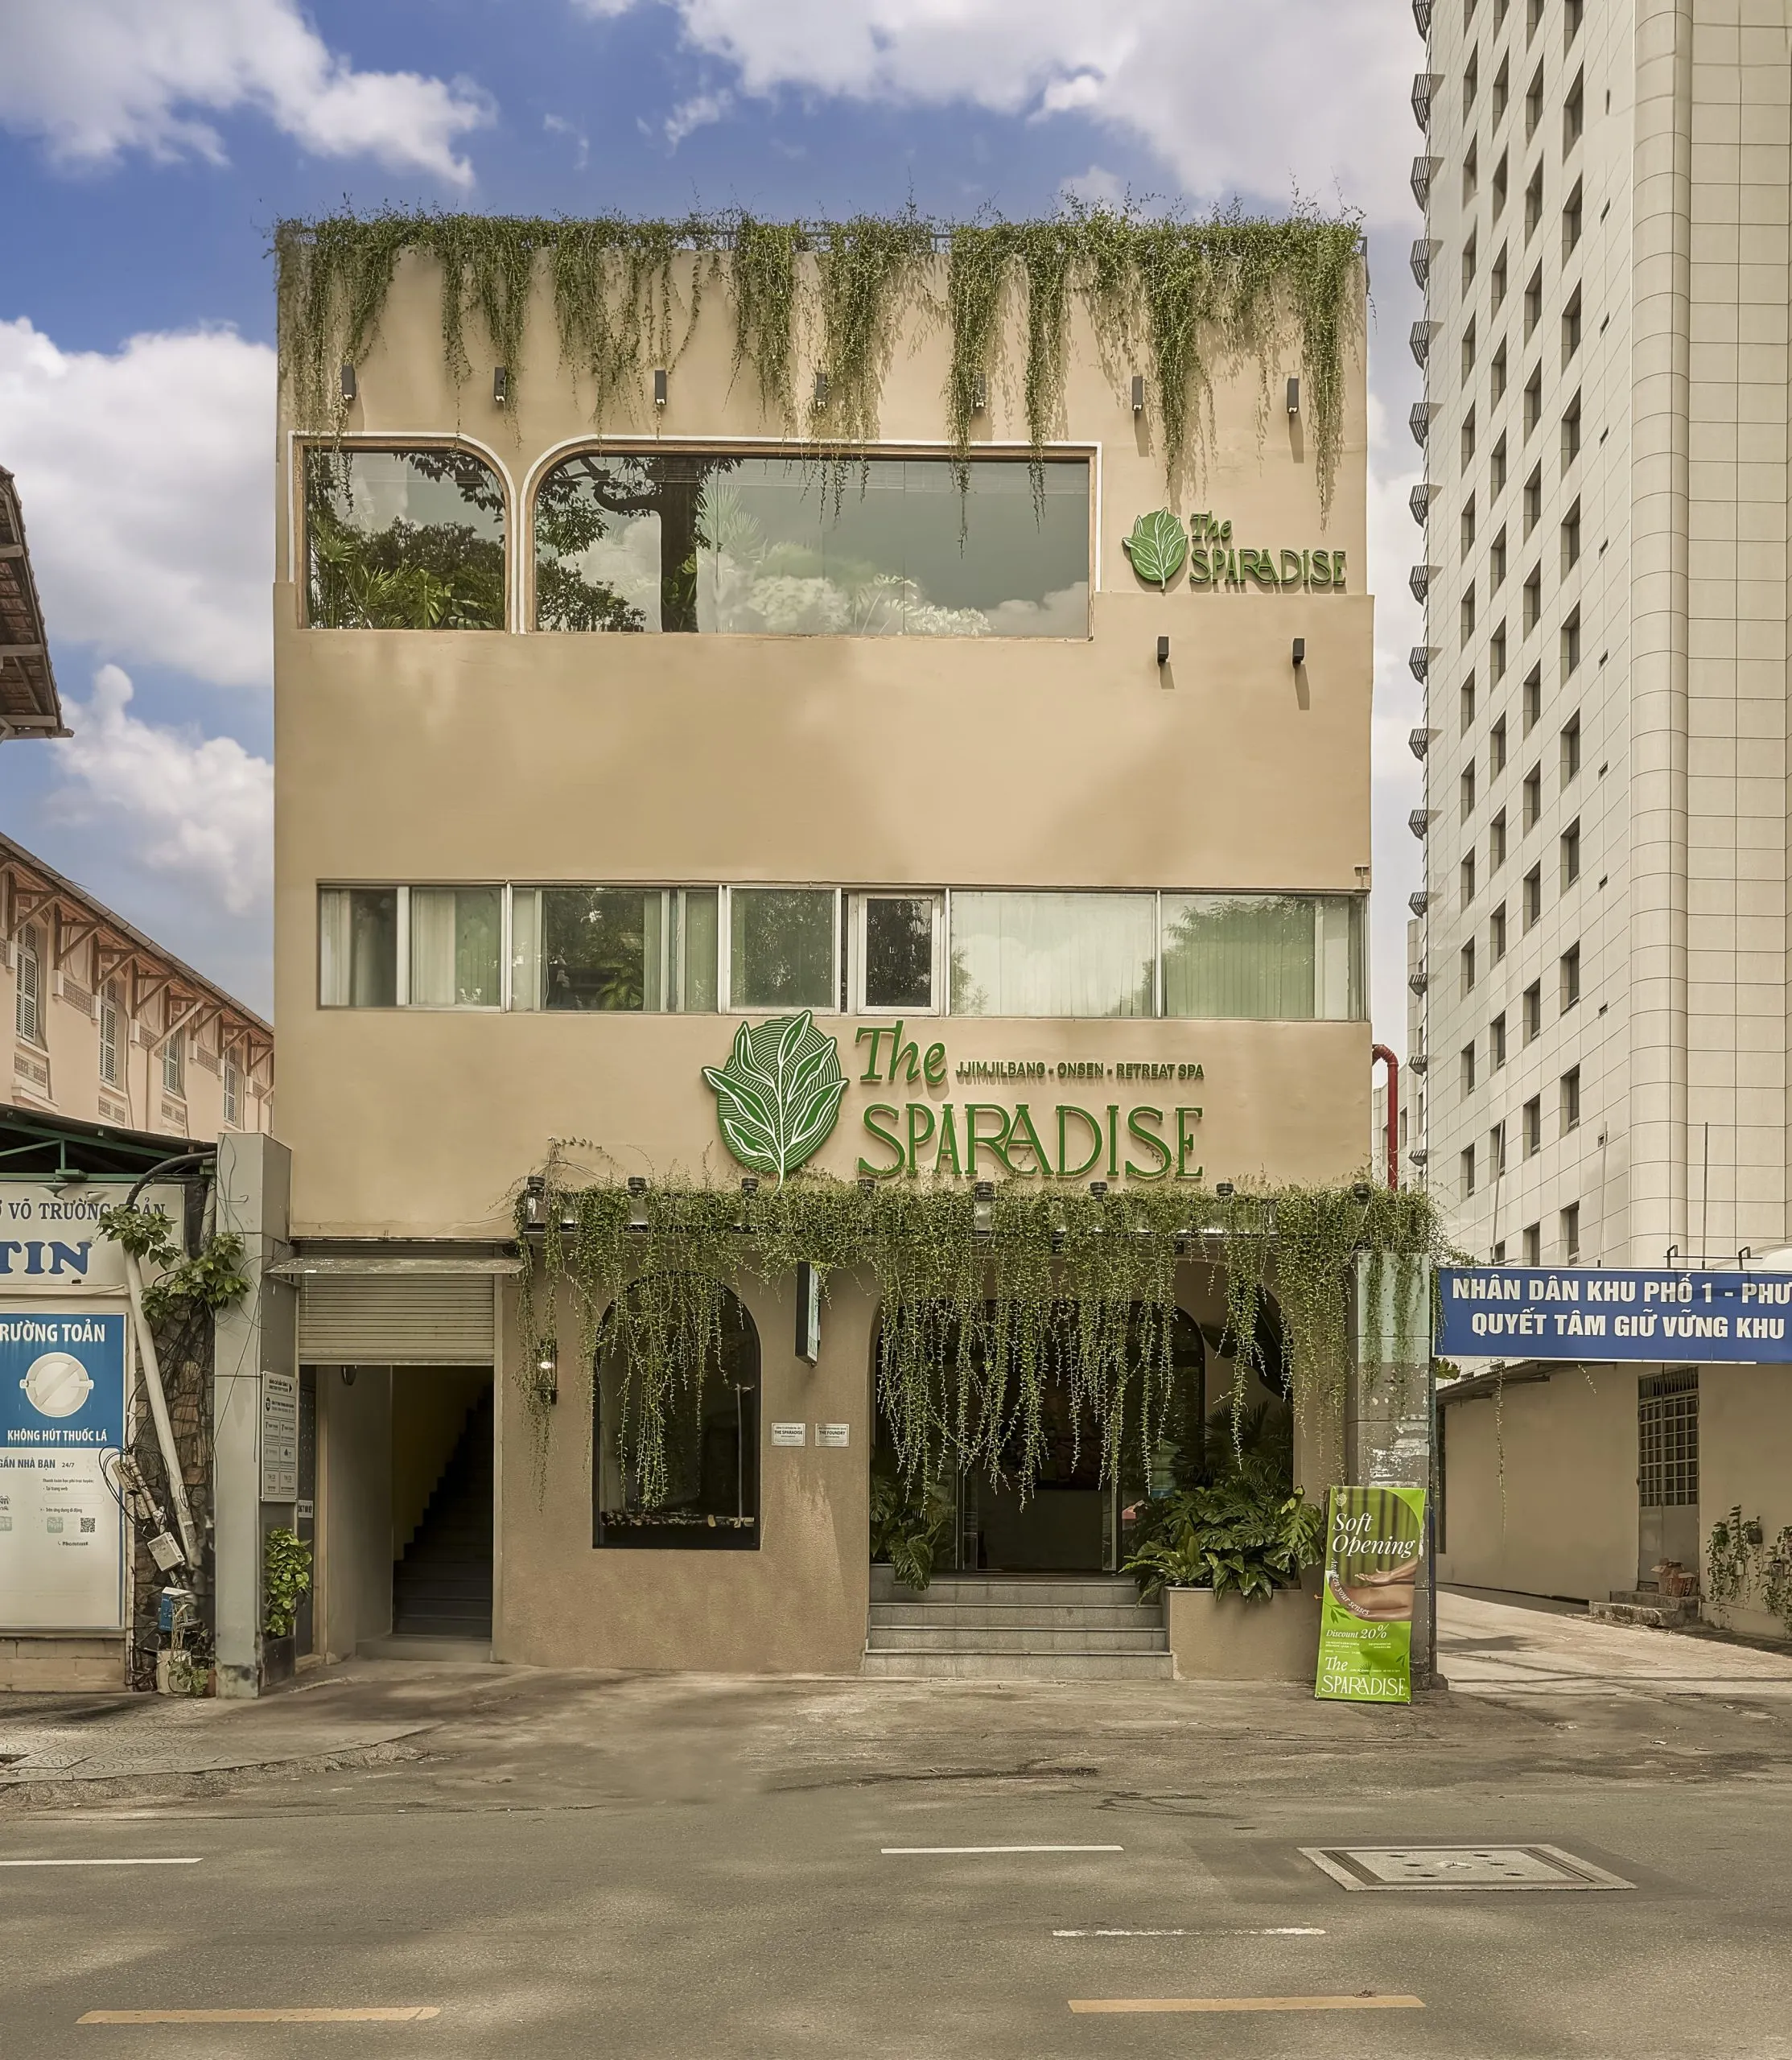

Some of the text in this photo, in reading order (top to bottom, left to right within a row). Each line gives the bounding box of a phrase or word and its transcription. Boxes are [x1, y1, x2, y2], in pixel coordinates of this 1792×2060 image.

[1189, 510, 1232, 540] The
[1189, 548, 1347, 586] SPARADISE
[855, 1020, 947, 1084] The
[955, 1061, 1046, 1077] JJIMJILBANG
[1057, 1062, 1104, 1078] ONSEN
[1116, 1063, 1176, 1079] RETREAT
[1178, 1064, 1205, 1080] SPA
[858, 1103, 1204, 1179] SPARADISE
[8, 1198, 31, 1220] VÕ
[1452, 1274, 1521, 1300] NHÂN
[1529, 1275, 1579, 1301] DÂN
[1587, 1280, 1635, 1302] KHU
[1644, 1273, 1693, 1303] PHỐ
[1701, 1283, 1712, 1304] 1
[62, 1318, 105, 1342] TOẢN
[1472, 1307, 1785, 1339] QUYẾT TÂM GIỮ VỮNG KHU
[7, 1427, 107, 1441] KHÔNG HÚT THUỐC LÁ
[17, 1457, 35, 1469] NHÀ
[38, 1459, 56, 1471] BẠN
[1332, 1512, 1374, 1535] Soft
[1332, 1534, 1416, 1559] Opening
[1334, 1588, 1351, 1602] your
[1325, 1623, 1389, 1639] Discount 20%
[1325, 1656, 1348, 1671] The
[1321, 1675, 1406, 1696] SPARADISE
